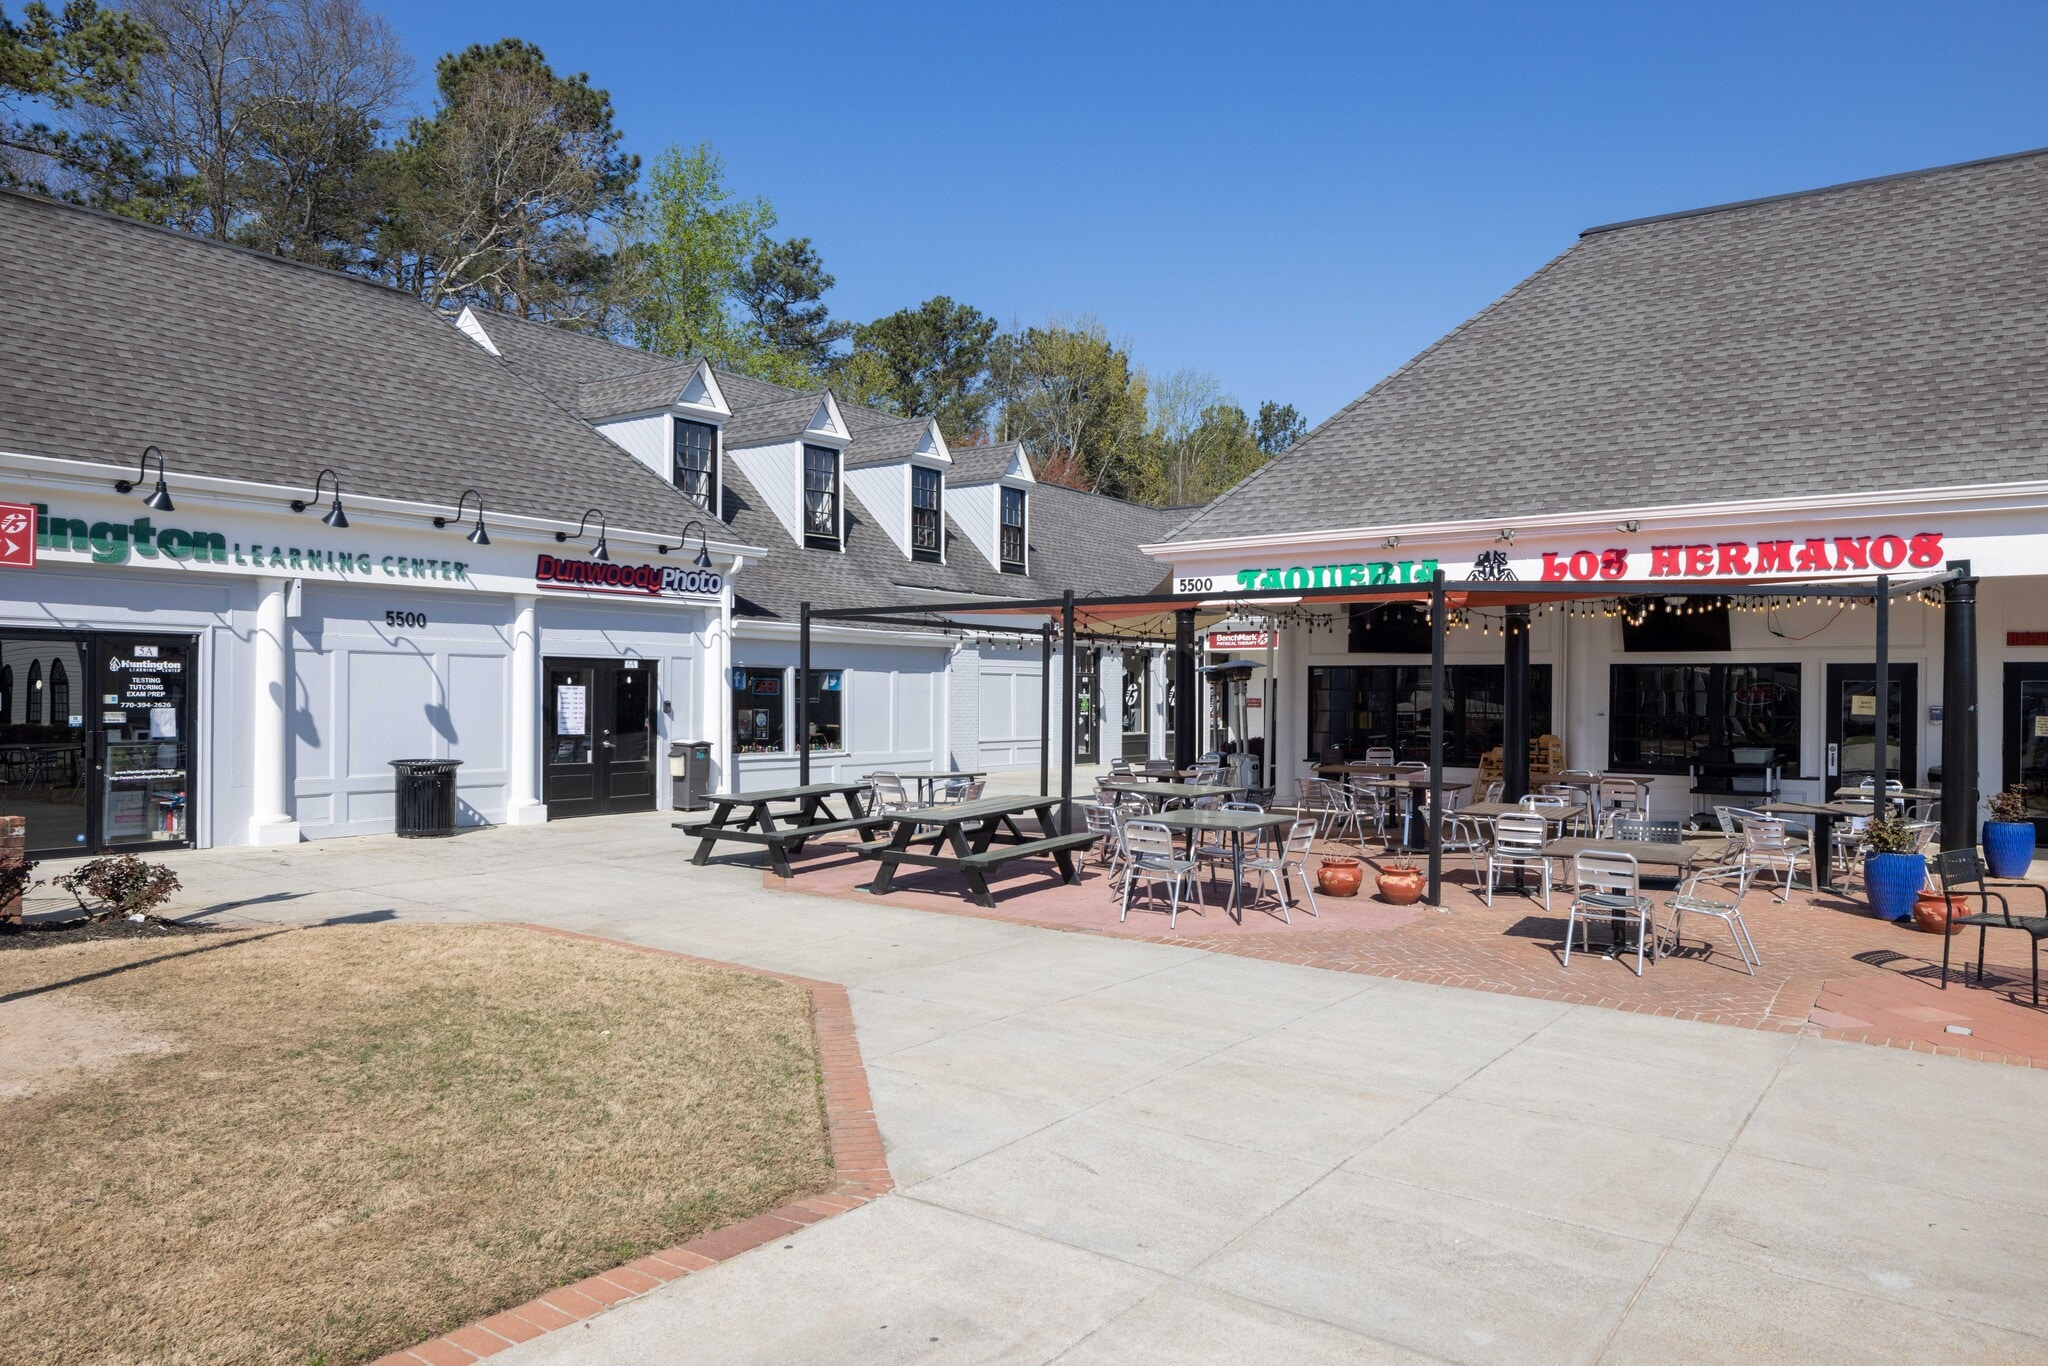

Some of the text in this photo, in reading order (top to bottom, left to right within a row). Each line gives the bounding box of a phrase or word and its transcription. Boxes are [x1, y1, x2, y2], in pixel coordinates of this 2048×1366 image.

[30, 503, 226, 563] ington
[234, 543, 371, 573] LEARNING
[1541, 532, 1944, 581] LOS HERMANOS
[1237, 559, 1438, 591] TAQUERIA
[1179, 578, 1212, 592] 5500
[385, 611, 427, 628] 5500
[1216, 634, 1257, 642] BenchMark
[139, 646, 153, 656] 5A
[120, 660, 181, 670] Huntington
[754, 681, 778, 692] OPEN
